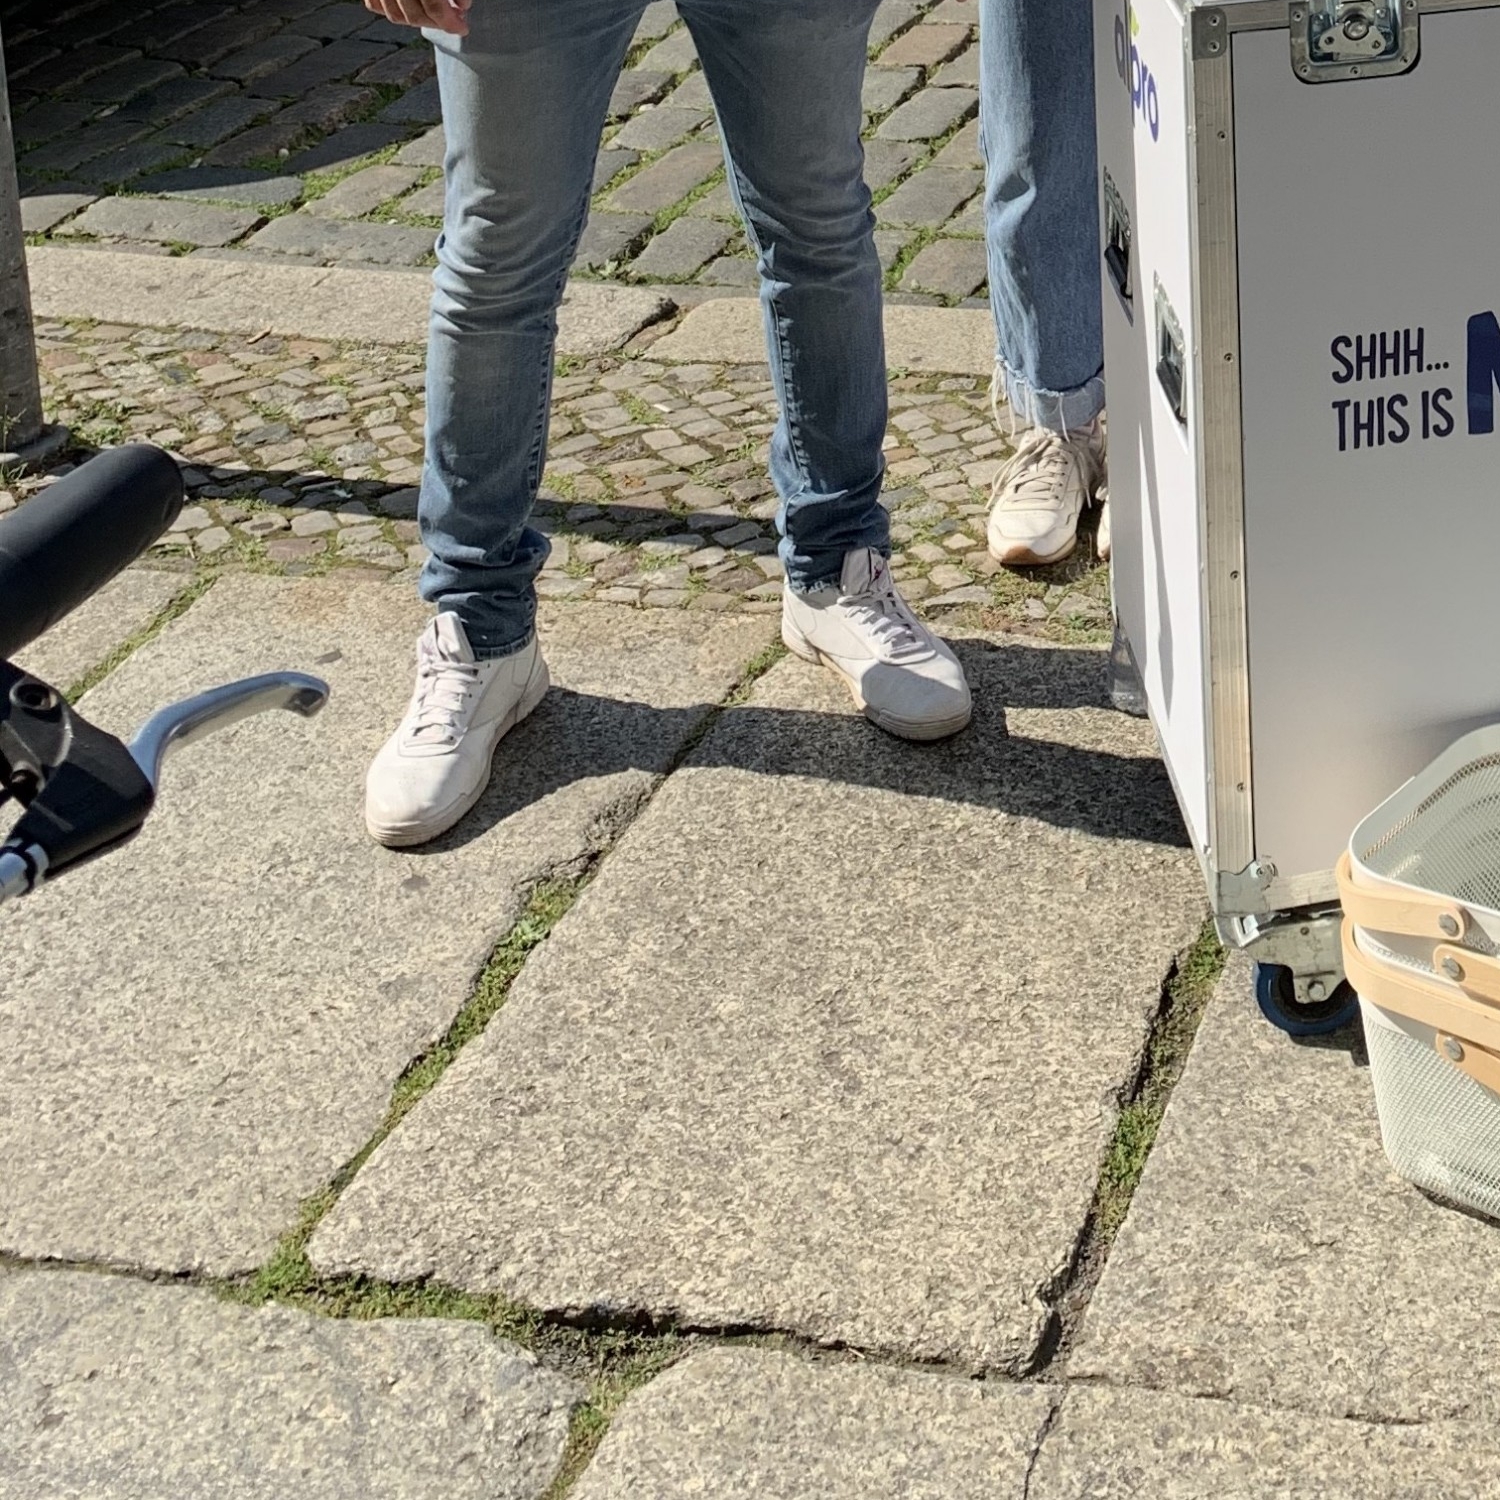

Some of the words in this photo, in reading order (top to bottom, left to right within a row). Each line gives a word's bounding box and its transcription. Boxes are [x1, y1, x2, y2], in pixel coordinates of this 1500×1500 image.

[1331, 327, 1450, 383] SHHH...
[1332, 394, 1410, 452] THIS
[1421, 387, 1454, 439] IS
